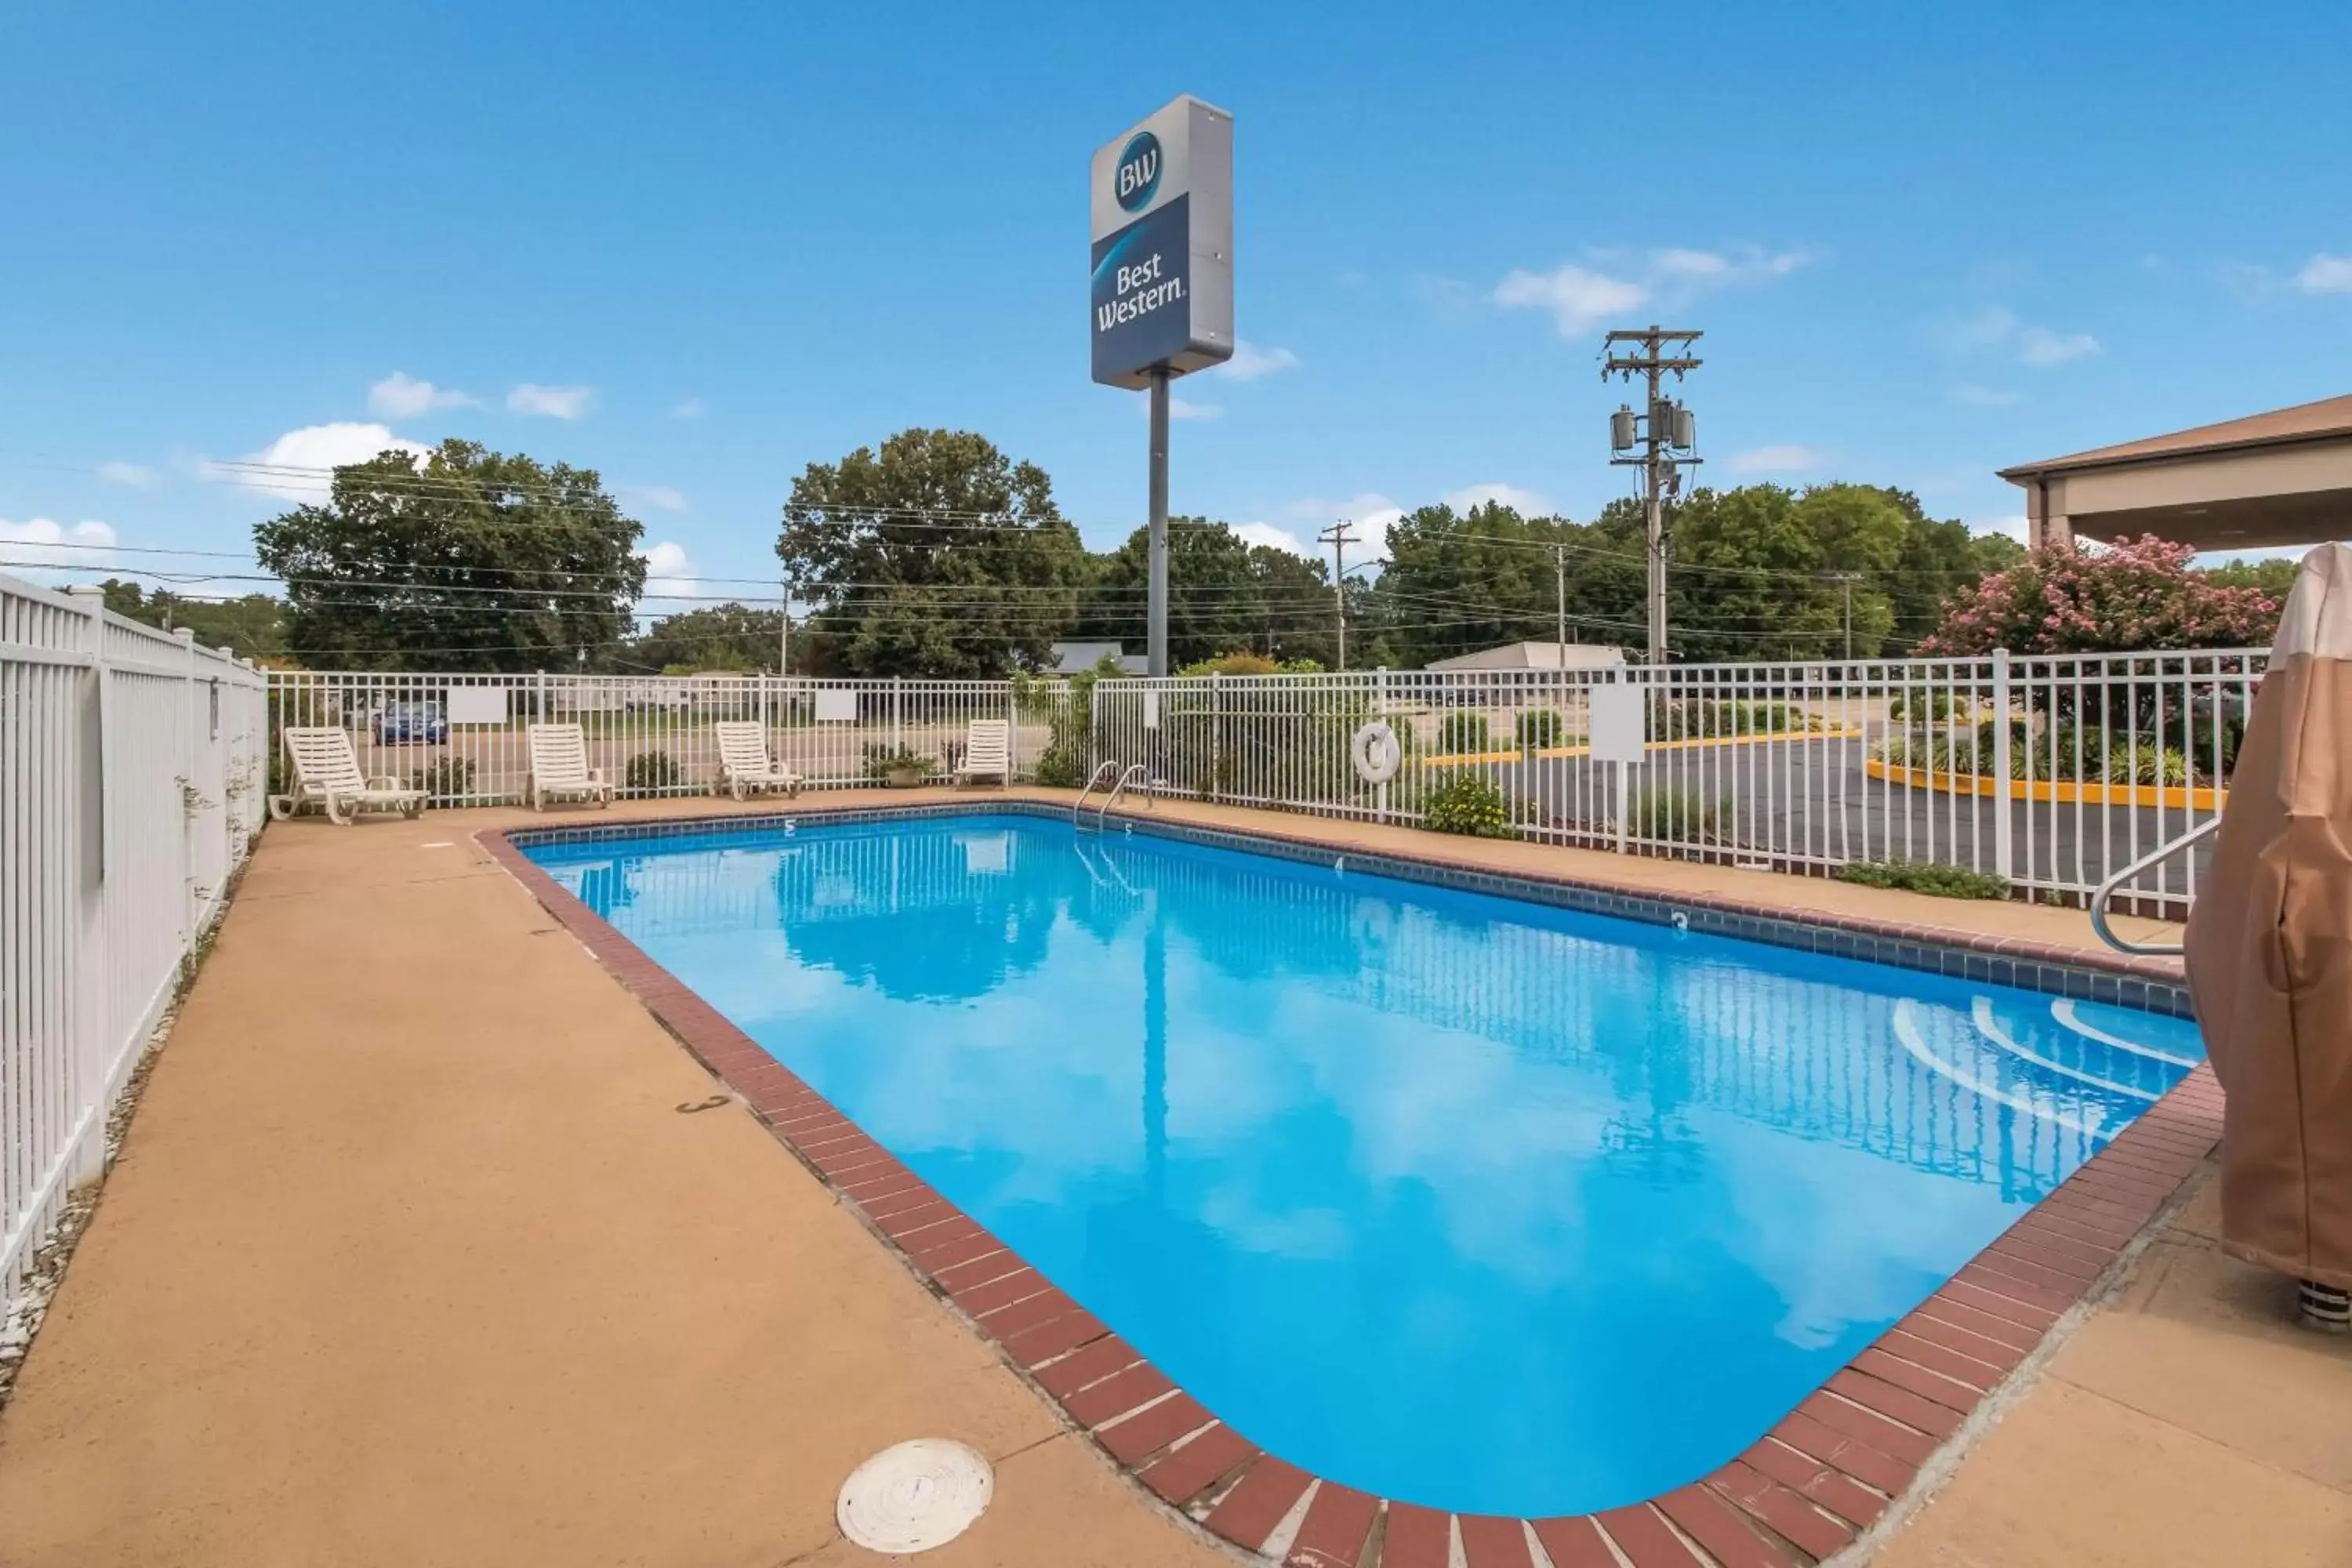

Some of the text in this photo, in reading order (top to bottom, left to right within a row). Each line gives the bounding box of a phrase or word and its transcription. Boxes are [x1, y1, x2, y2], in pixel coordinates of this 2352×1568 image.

[1120, 148, 1156, 197] BW
[1117, 252, 1161, 296] Best
[1098, 277, 1181, 332] Western
